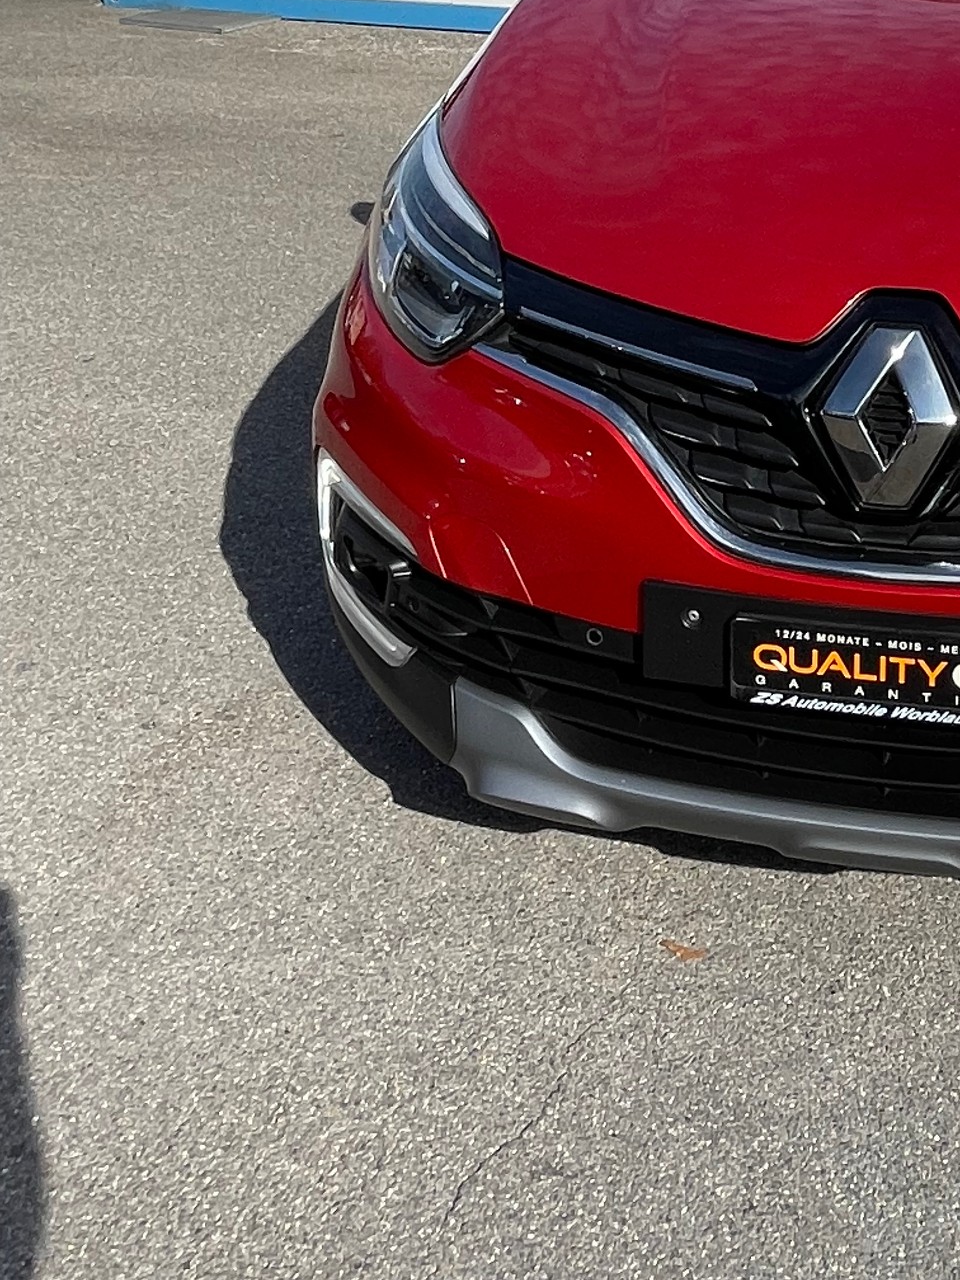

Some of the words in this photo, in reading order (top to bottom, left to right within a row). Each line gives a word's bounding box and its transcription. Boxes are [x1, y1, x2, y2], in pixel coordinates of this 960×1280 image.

[774, 628, 811, 641] 12/24
[816, 632, 870, 647] MONATE
[887, 639, 922, 652] MOIS
[749, 691, 783, 705] ZS
[780, 695, 888, 719] Automobile
